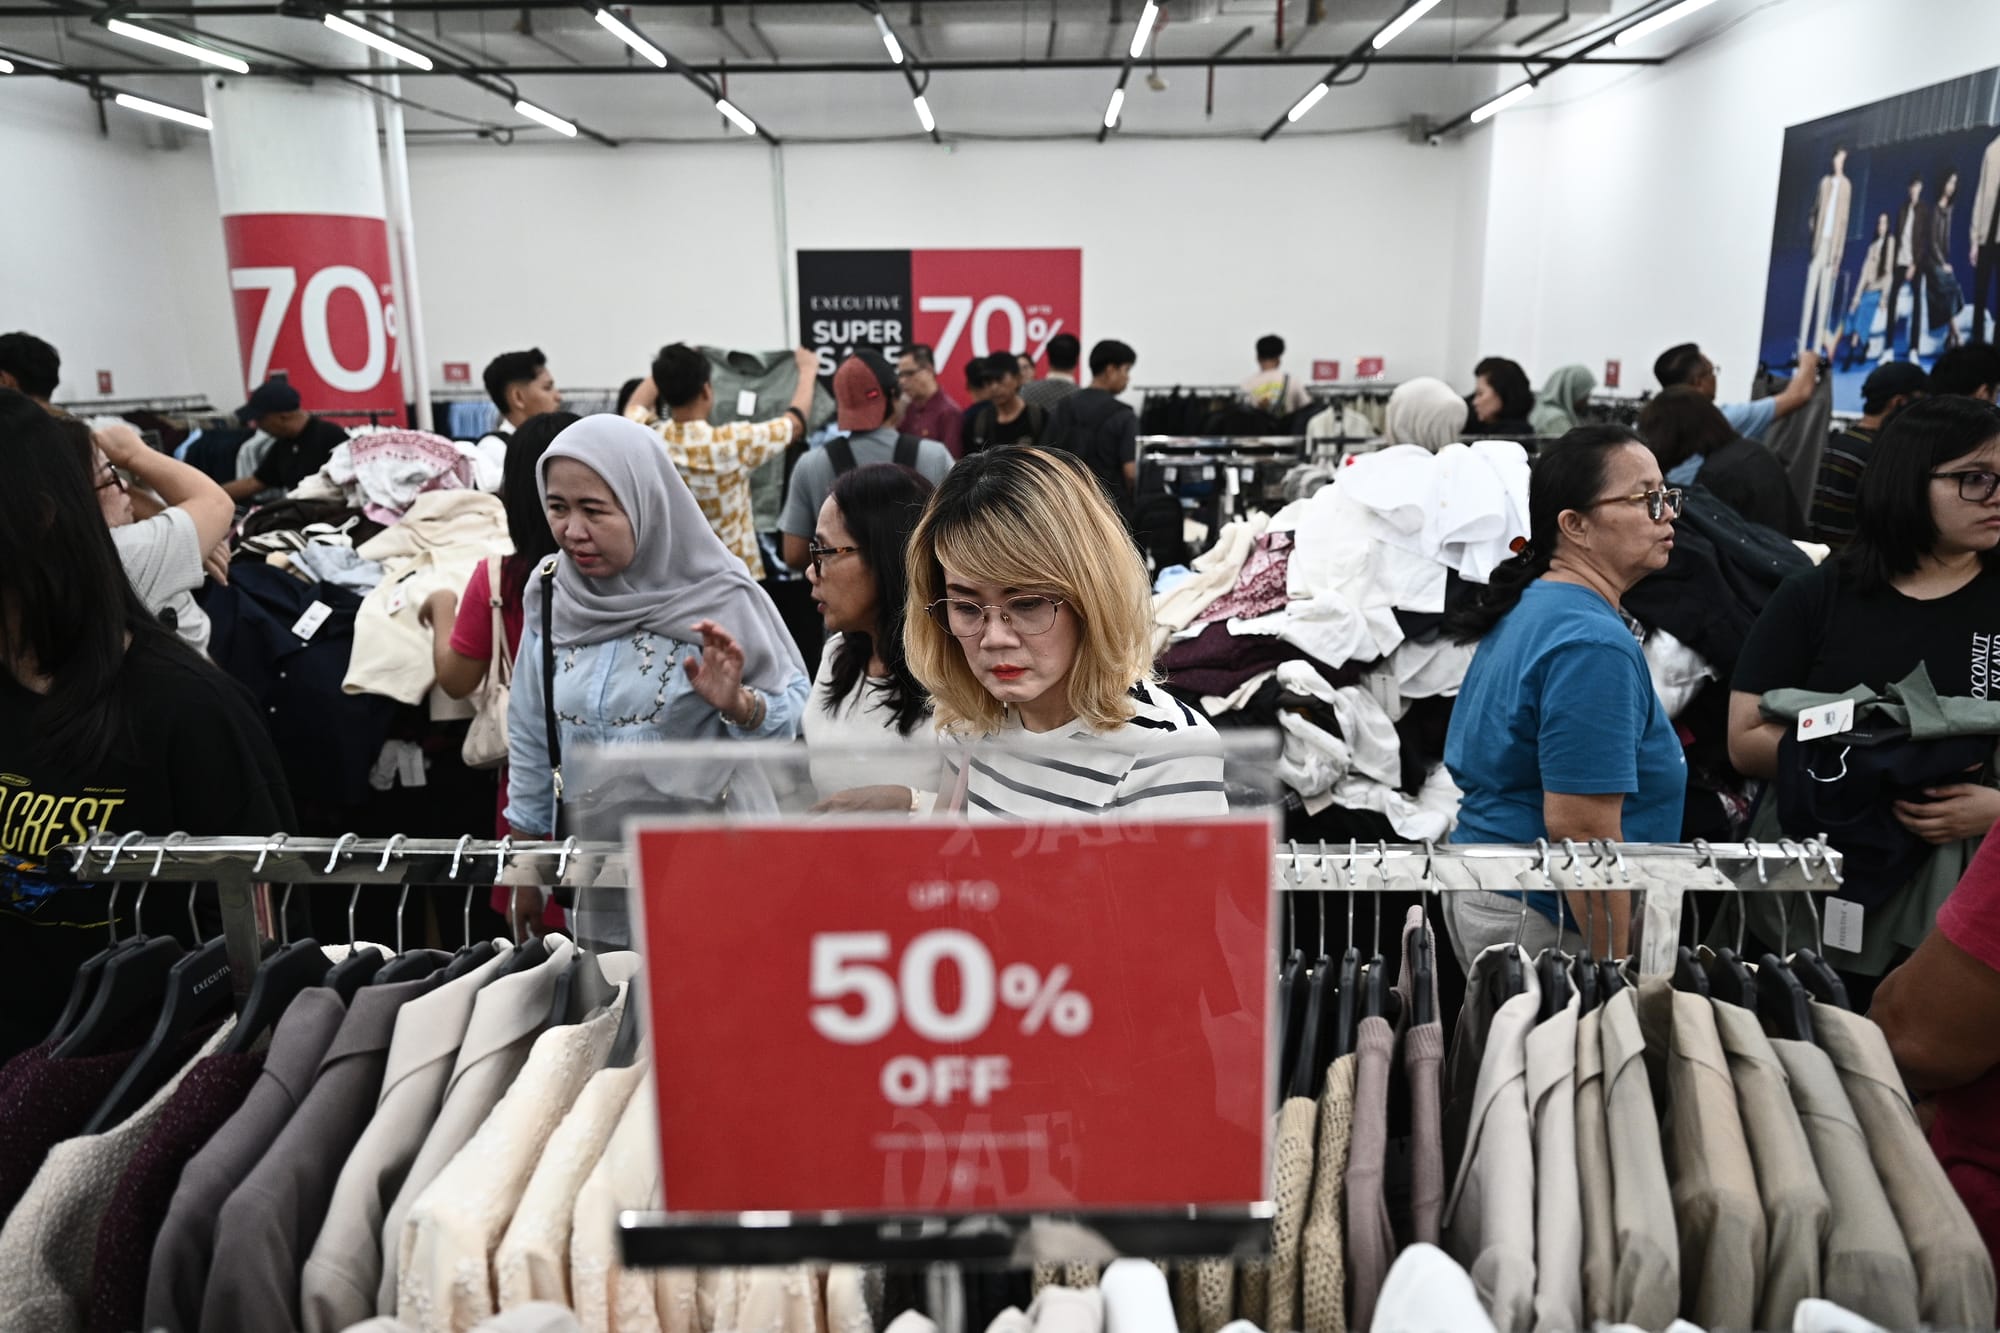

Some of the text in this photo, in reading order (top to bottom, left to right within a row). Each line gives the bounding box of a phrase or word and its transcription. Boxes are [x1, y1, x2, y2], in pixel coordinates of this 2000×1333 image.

[810, 295, 901, 311] EXECUTIVE
[812, 320, 902, 344] SUPER
[815, 346, 902, 376] SE
[1970, 632, 1988, 700] OCONUT
[908, 880, 1000, 911] UP TO
[192, 964, 232, 996] EXECUTIV
[809, 928, 1093, 1045] 50%
[880, 1055, 1012, 1107] OFF
